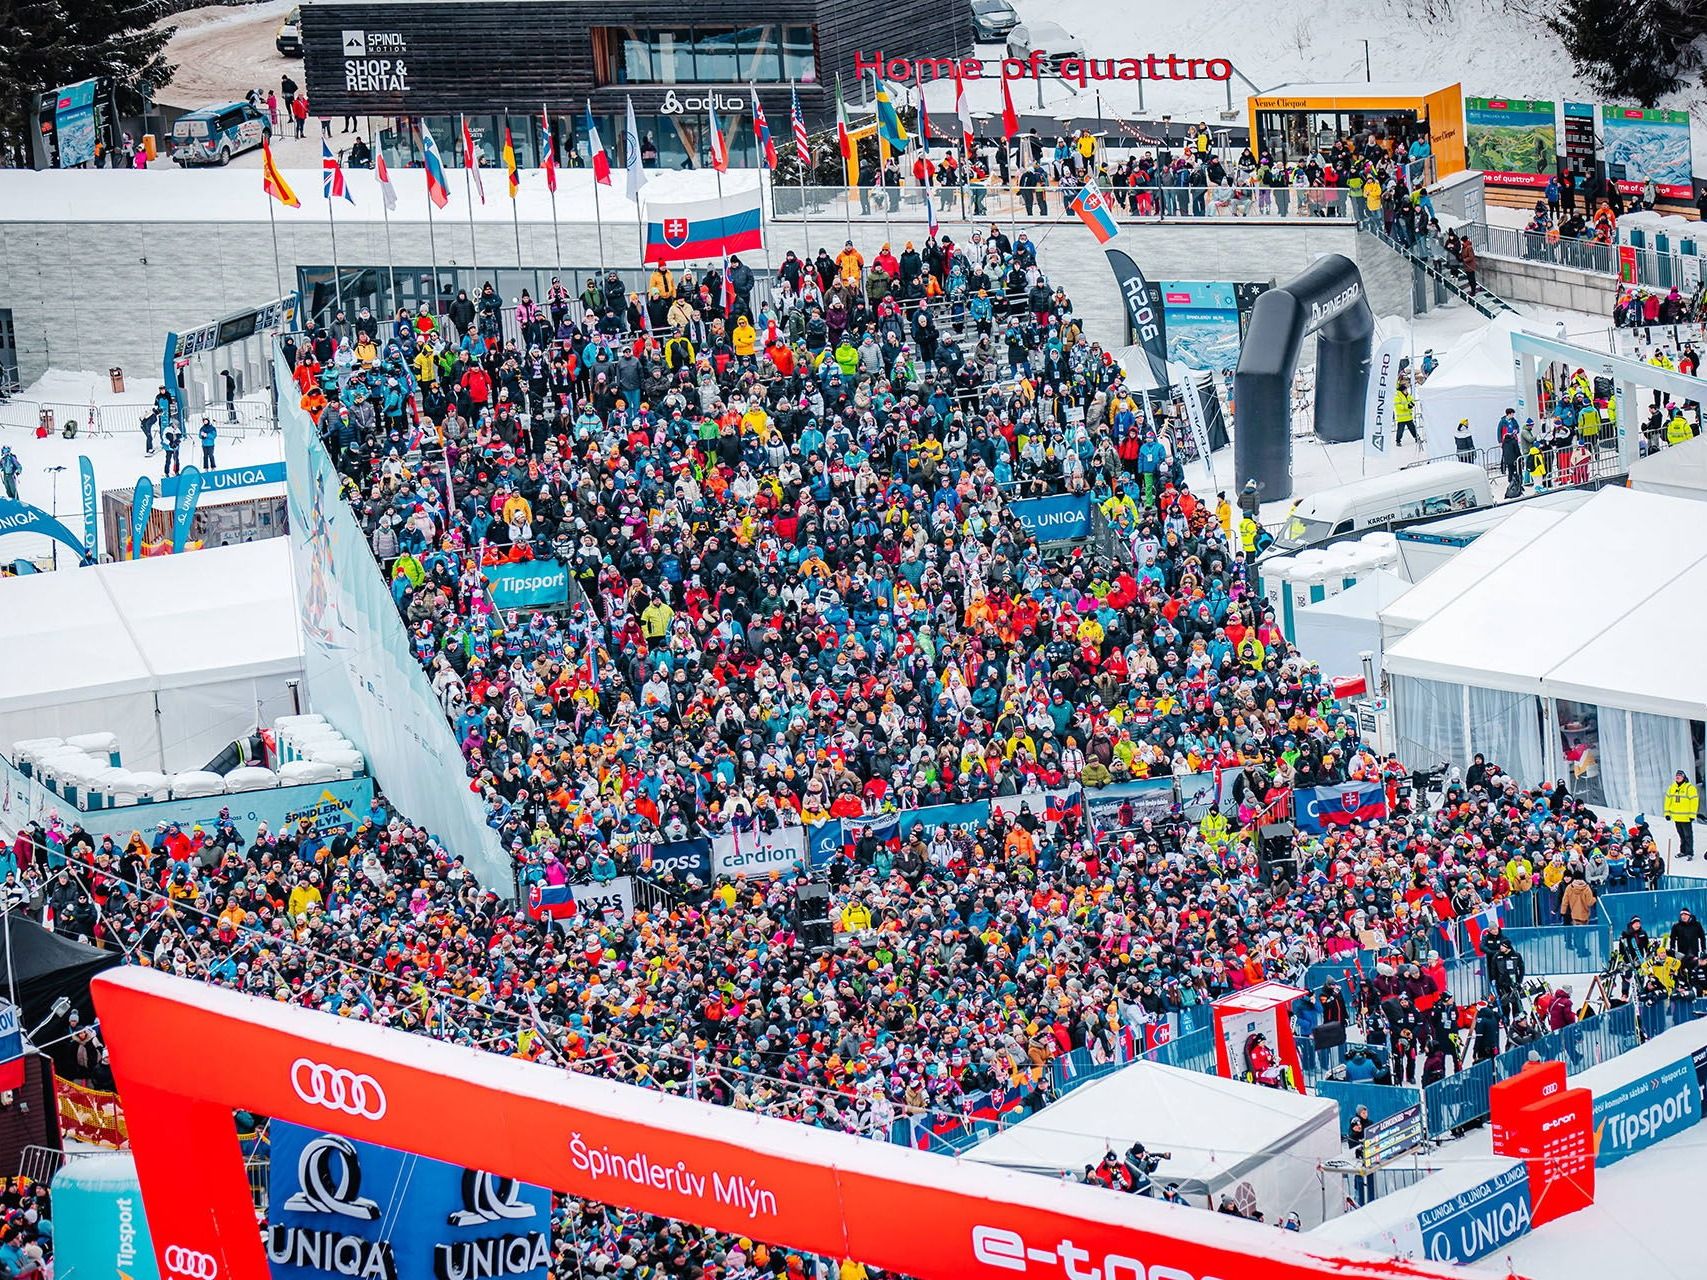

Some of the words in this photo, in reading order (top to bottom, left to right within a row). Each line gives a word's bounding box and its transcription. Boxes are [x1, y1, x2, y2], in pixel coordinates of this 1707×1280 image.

[368, 33, 406, 46] SPINDL
[345, 60, 391, 76] SHOP
[395, 60, 408, 76] &
[855, 50, 983, 82] Home
[1002, 49, 1046, 81] of
[1059, 53, 1233, 89] quattro
[346, 75, 411, 91] RENTAL
[685, 93, 744, 110] odlo
[1254, 99, 1276, 108] Veuve
[1276, 98, 1307, 110] Clicquot
[1494, 174, 1502, 182] of
[1371, 387, 1385, 453] ALPINE
[1380, 353, 1391, 387] PRO
[214, 469, 266, 488] UNIQA
[183, 482, 198, 511] UNIQA
[138, 494, 151, 521] UNIQA
[0, 510, 39, 529] NIQA
[1037, 510, 1086, 527] UNIQA
[502, 572, 565, 594] Tipsport
[423, 643, 431, 655] P
[316, 814, 341, 828] LÝN
[925, 818, 980, 837] Tiort
[723, 844, 797, 867] cardion
[0, 1010, 14, 1032] OV
[1542, 1112, 1576, 1132] e-tron
[1608, 1083, 1692, 1149] Tipsport
[569, 1131, 706, 1198] Špindlerův
[711, 1171, 778, 1219] Mlýn
[1503, 1166, 1527, 1185] UNIQA
[1467, 1184, 1492, 1203] UNIQA
[1432, 1201, 1454, 1221] UNIQA
[116, 1197, 136, 1267] Tipsport
[1461, 1195, 1531, 1257] UNIQA
[268, 1224, 388, 1280] UNIQA
[444, 1231, 553, 1280] UNIQA
